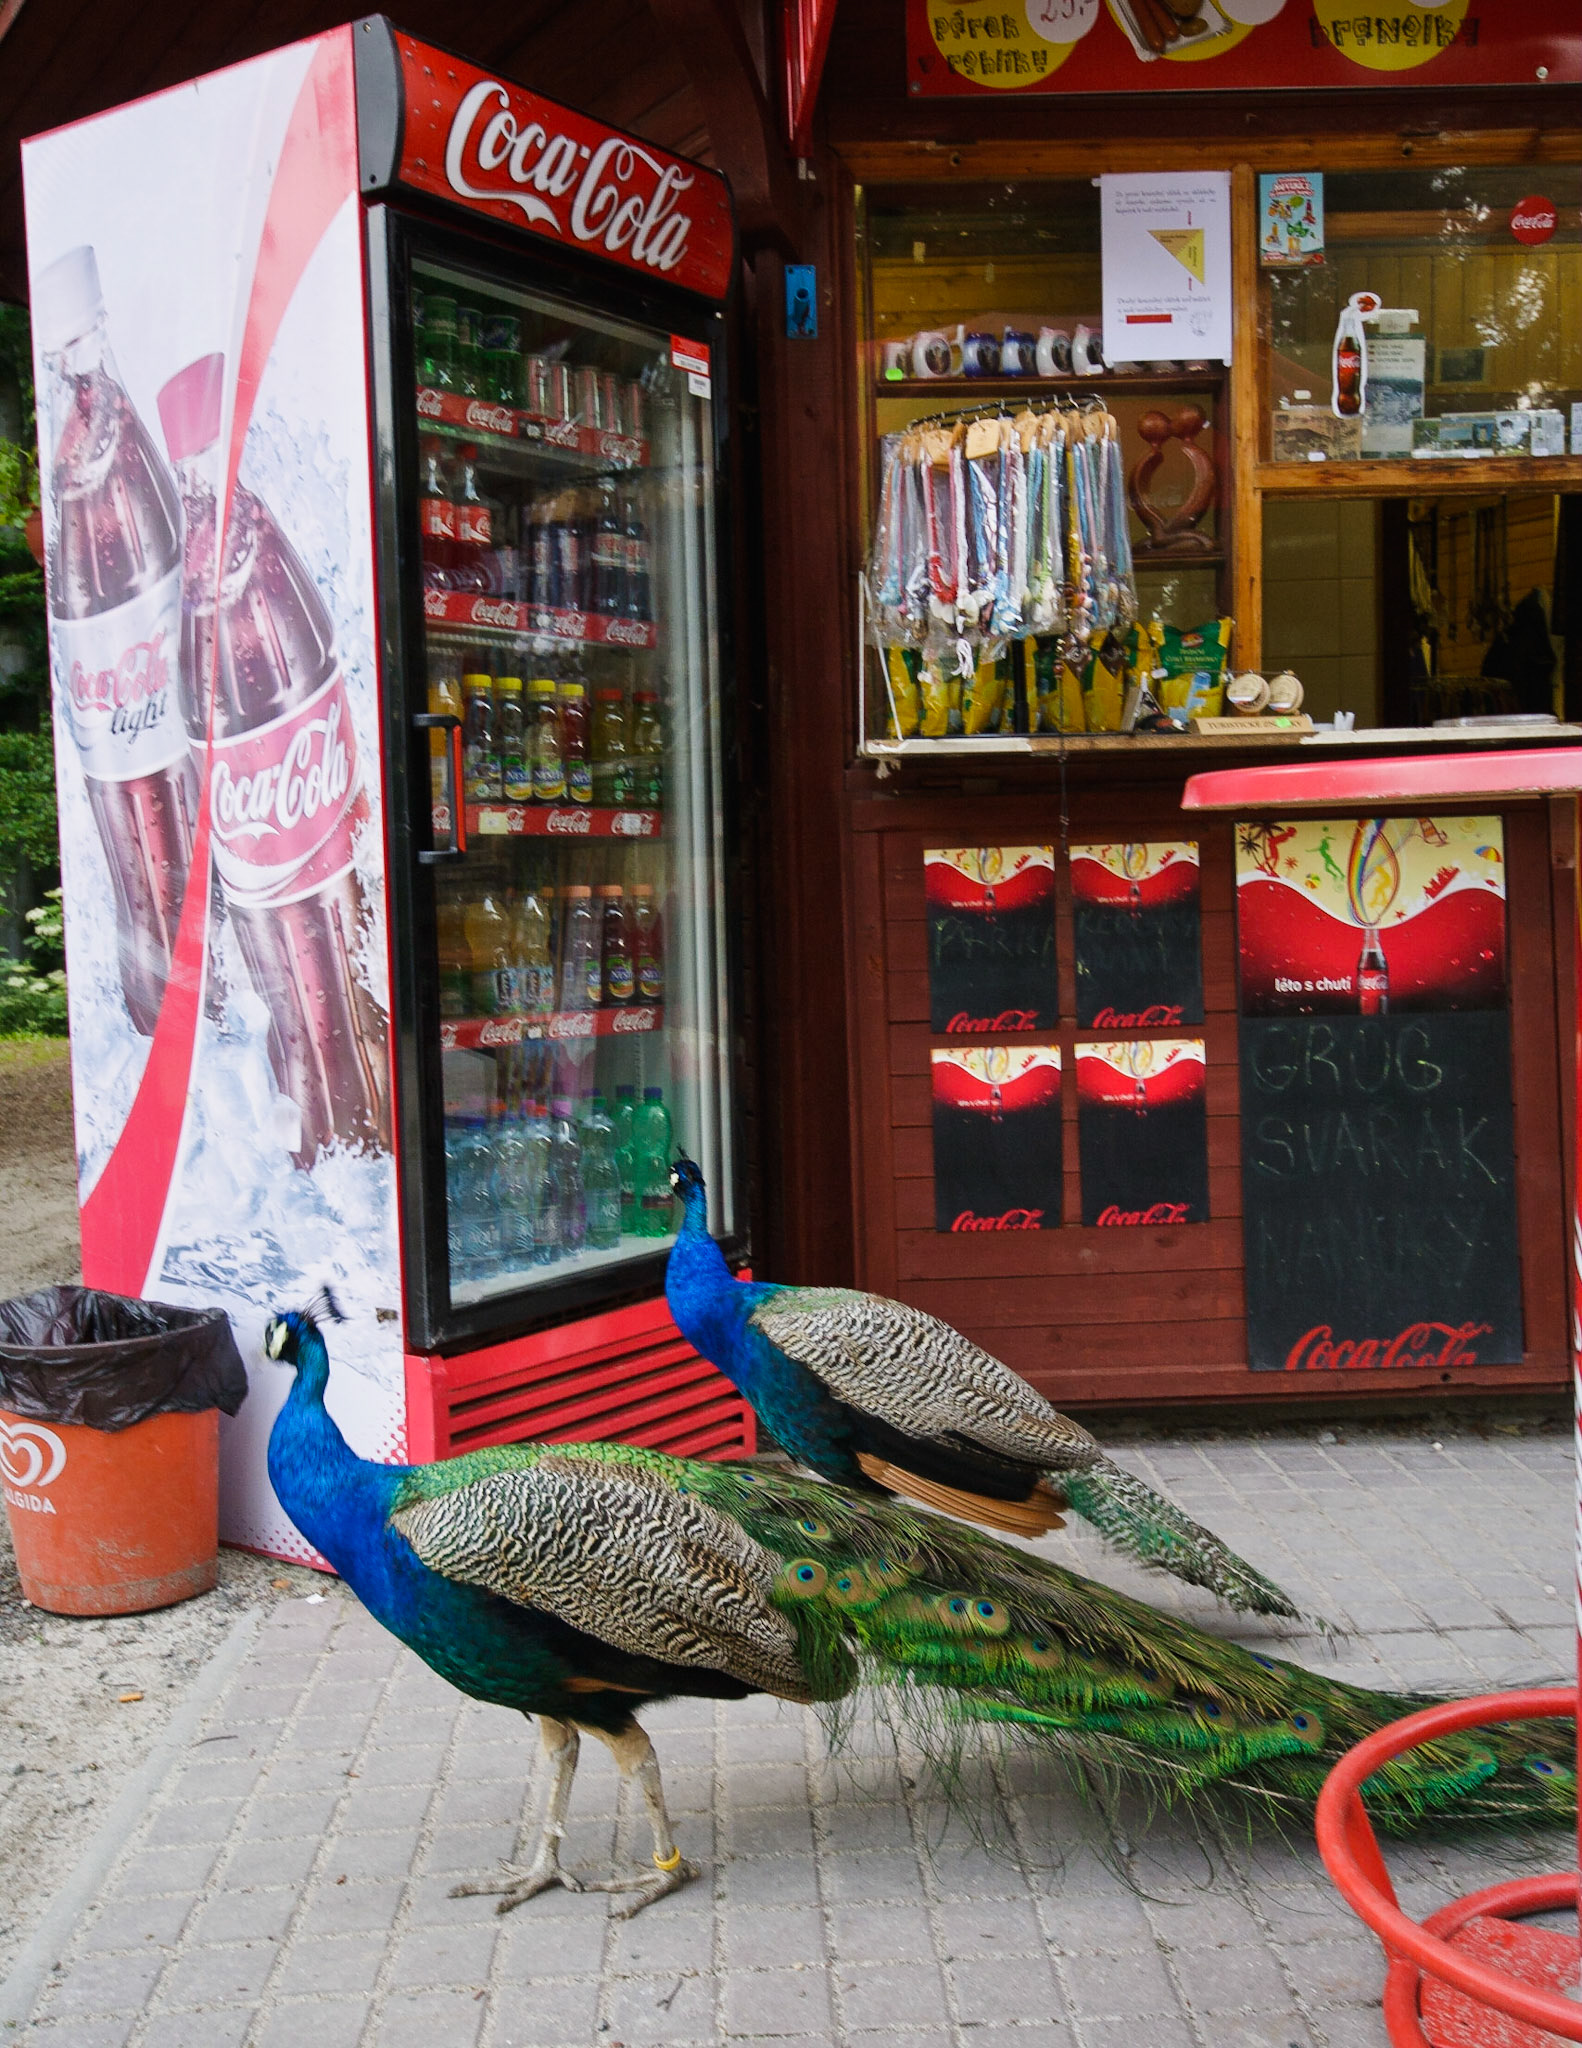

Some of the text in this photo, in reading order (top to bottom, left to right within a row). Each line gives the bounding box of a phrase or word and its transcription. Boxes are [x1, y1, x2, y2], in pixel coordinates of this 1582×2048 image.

[445, 80, 694, 271] Coca-Cola
[70, 631, 168, 712] Coca-Cola
[111, 690, 167, 745] light
[210, 702, 349, 841] Coca-Cola
[1275, 978, 1303, 993] léto
[1304, 980, 1314, 992] s
